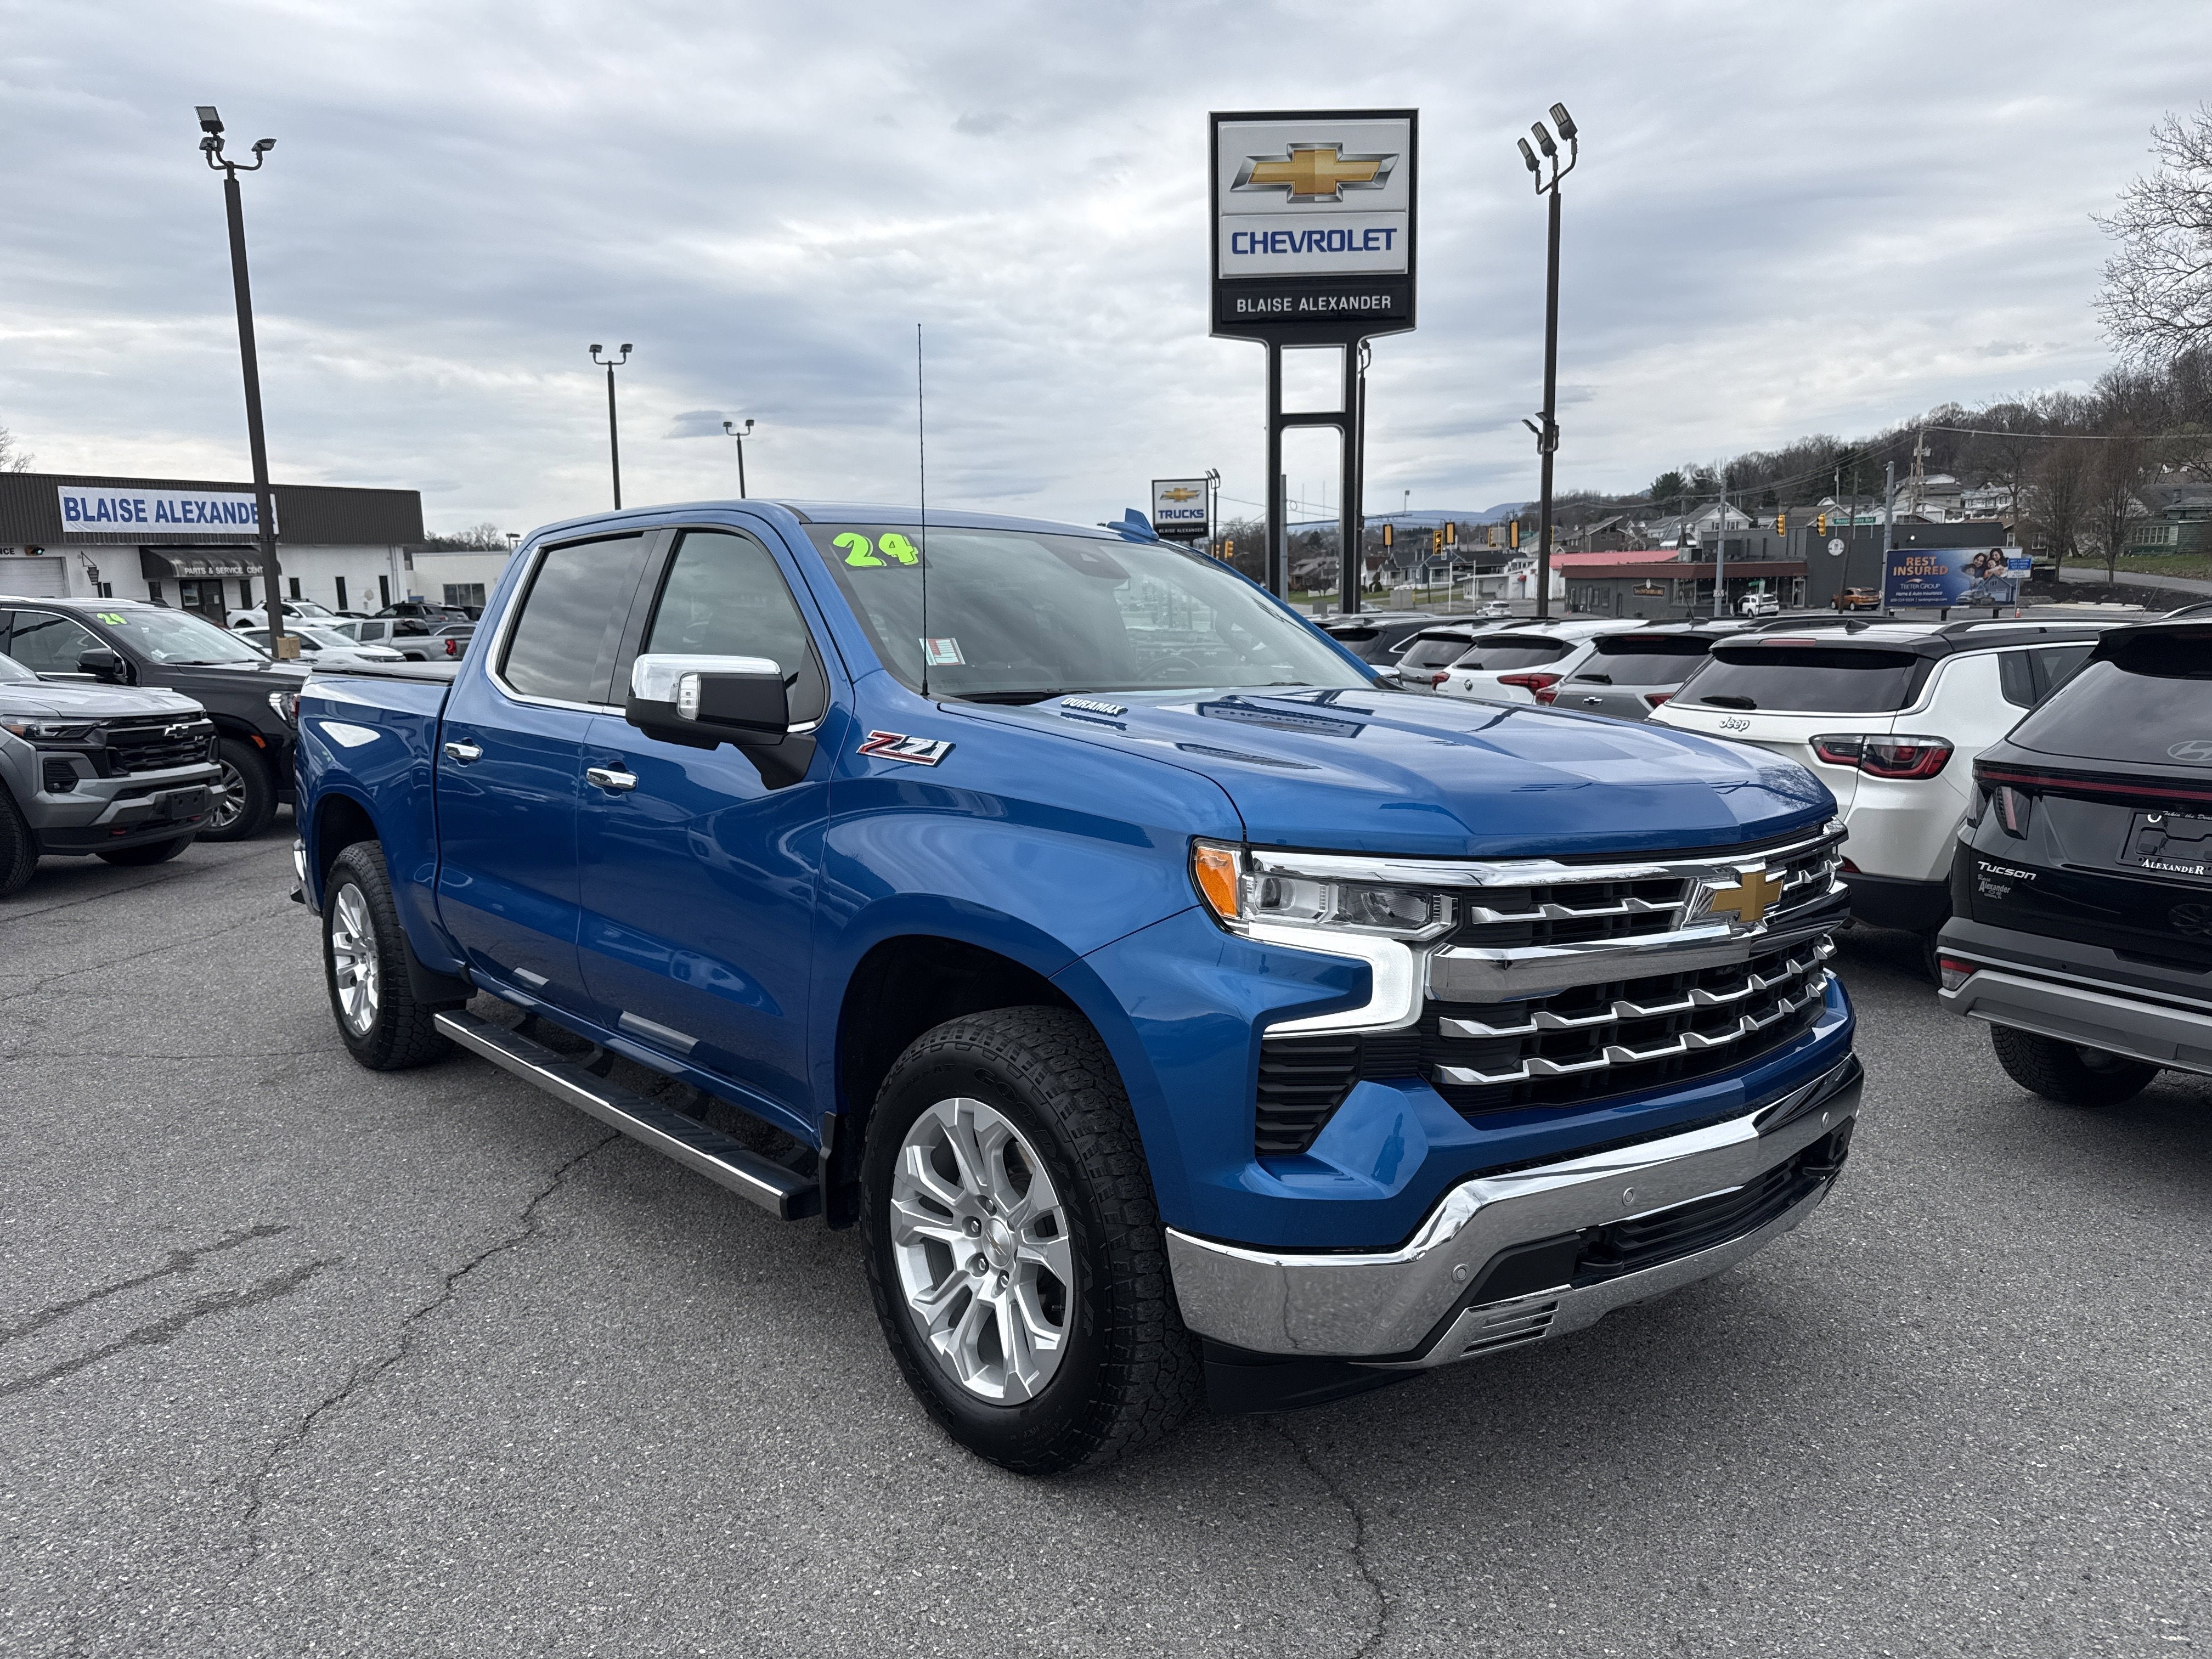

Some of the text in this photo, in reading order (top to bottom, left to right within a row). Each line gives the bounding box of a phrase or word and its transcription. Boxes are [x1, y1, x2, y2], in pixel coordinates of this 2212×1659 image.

[1232, 228, 1397, 255] CHEVROLET
[1237, 295, 1392, 313] BLAISE ALEXANDER
[63, 496, 276, 525] BLAISE ALEXANDE
[1158, 509, 1204, 520] TRUCKS
[833, 532, 919, 568] 24
[1906, 556, 1937, 567] REST
[184, 567, 206, 575] PARTS
[247, 566, 264, 574] CENT
[1893, 565, 1949, 577] INSURED
[97, 613, 128, 625] 24
[1060, 697, 1127, 716] DURAMAX
[1719, 716, 1751, 732] Jeep
[856, 729, 956, 768] Z71
[2141, 859, 2204, 875] ALEXANDER
[1978, 880, 2011, 894] Alexander
[973, 1068, 1095, 1338] GOODYEAR
